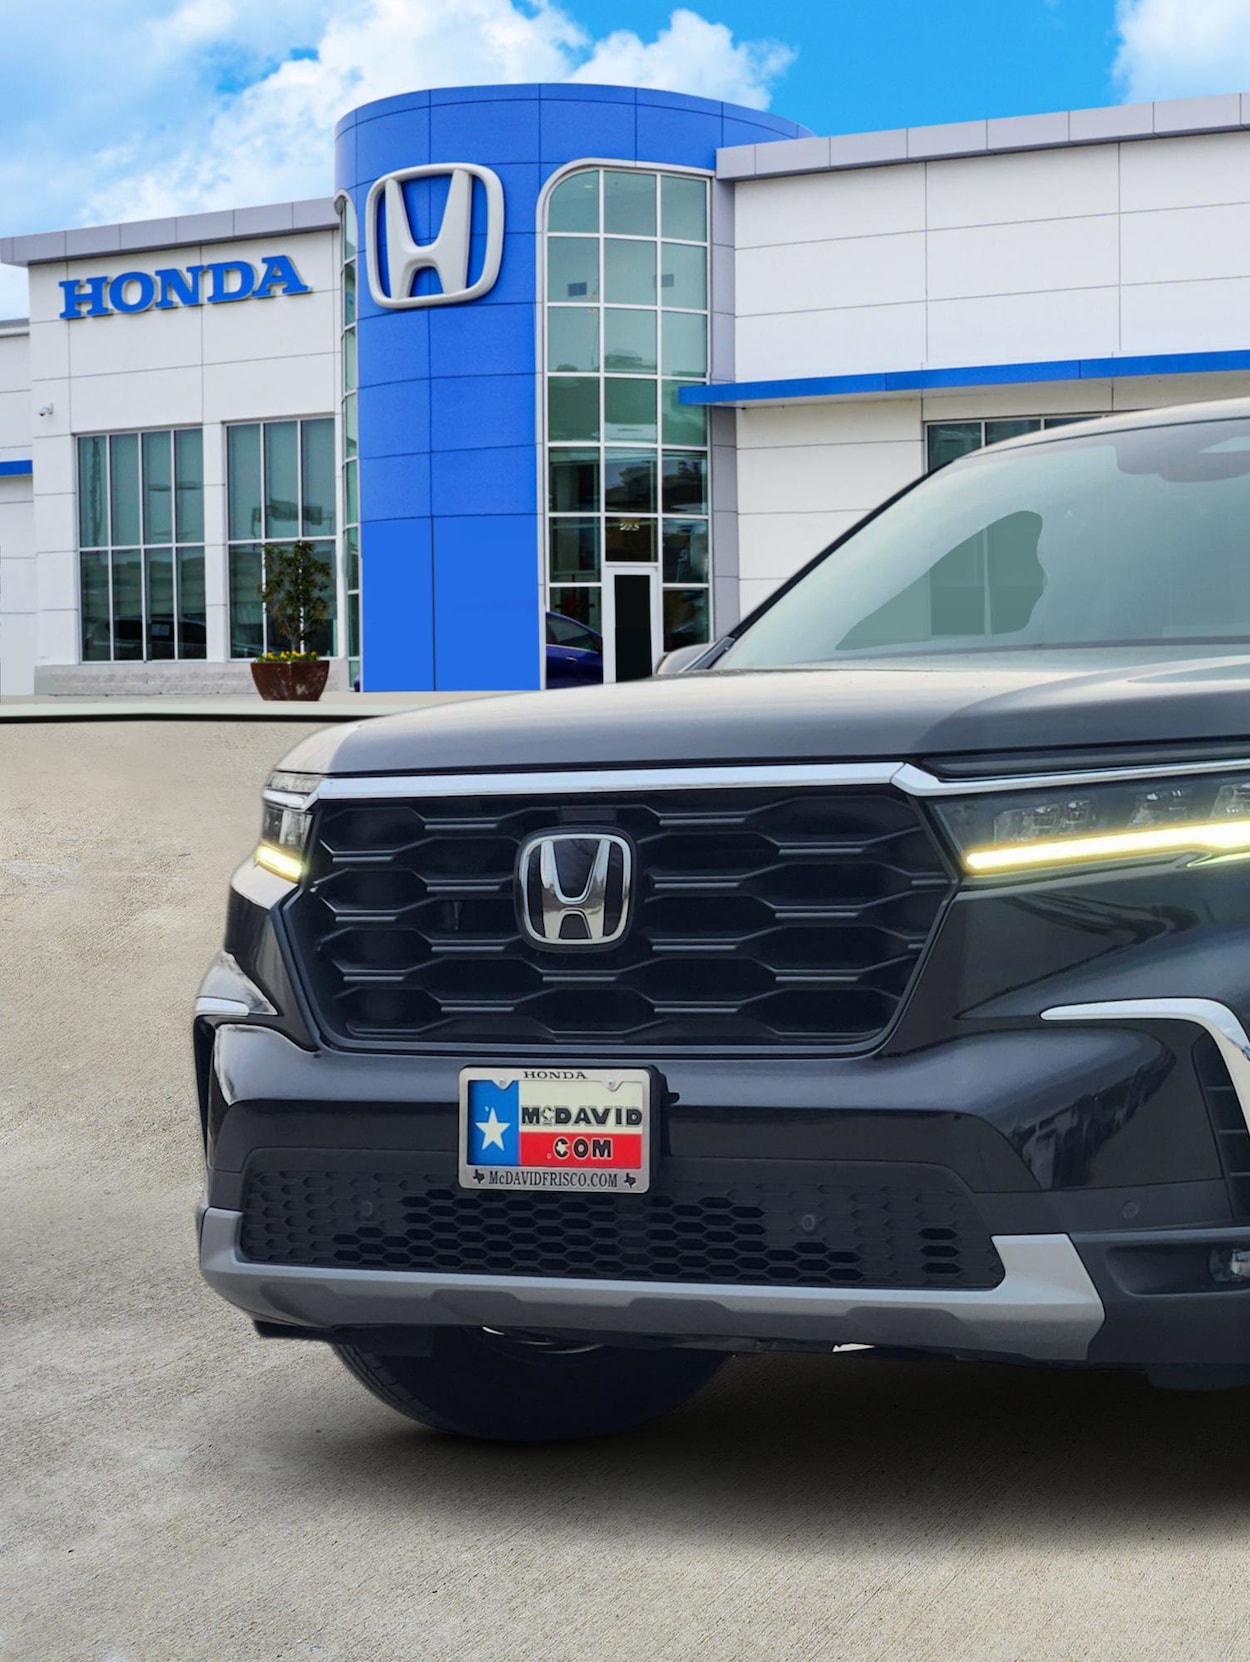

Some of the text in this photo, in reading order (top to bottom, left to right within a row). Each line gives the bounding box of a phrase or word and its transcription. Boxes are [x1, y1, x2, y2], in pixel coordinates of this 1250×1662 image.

[58, 254, 311, 320] HONDA
[523, 1070, 588, 1080] HONDA
[488, 1170, 619, 1188] McDAVIDFRISCO.COM
